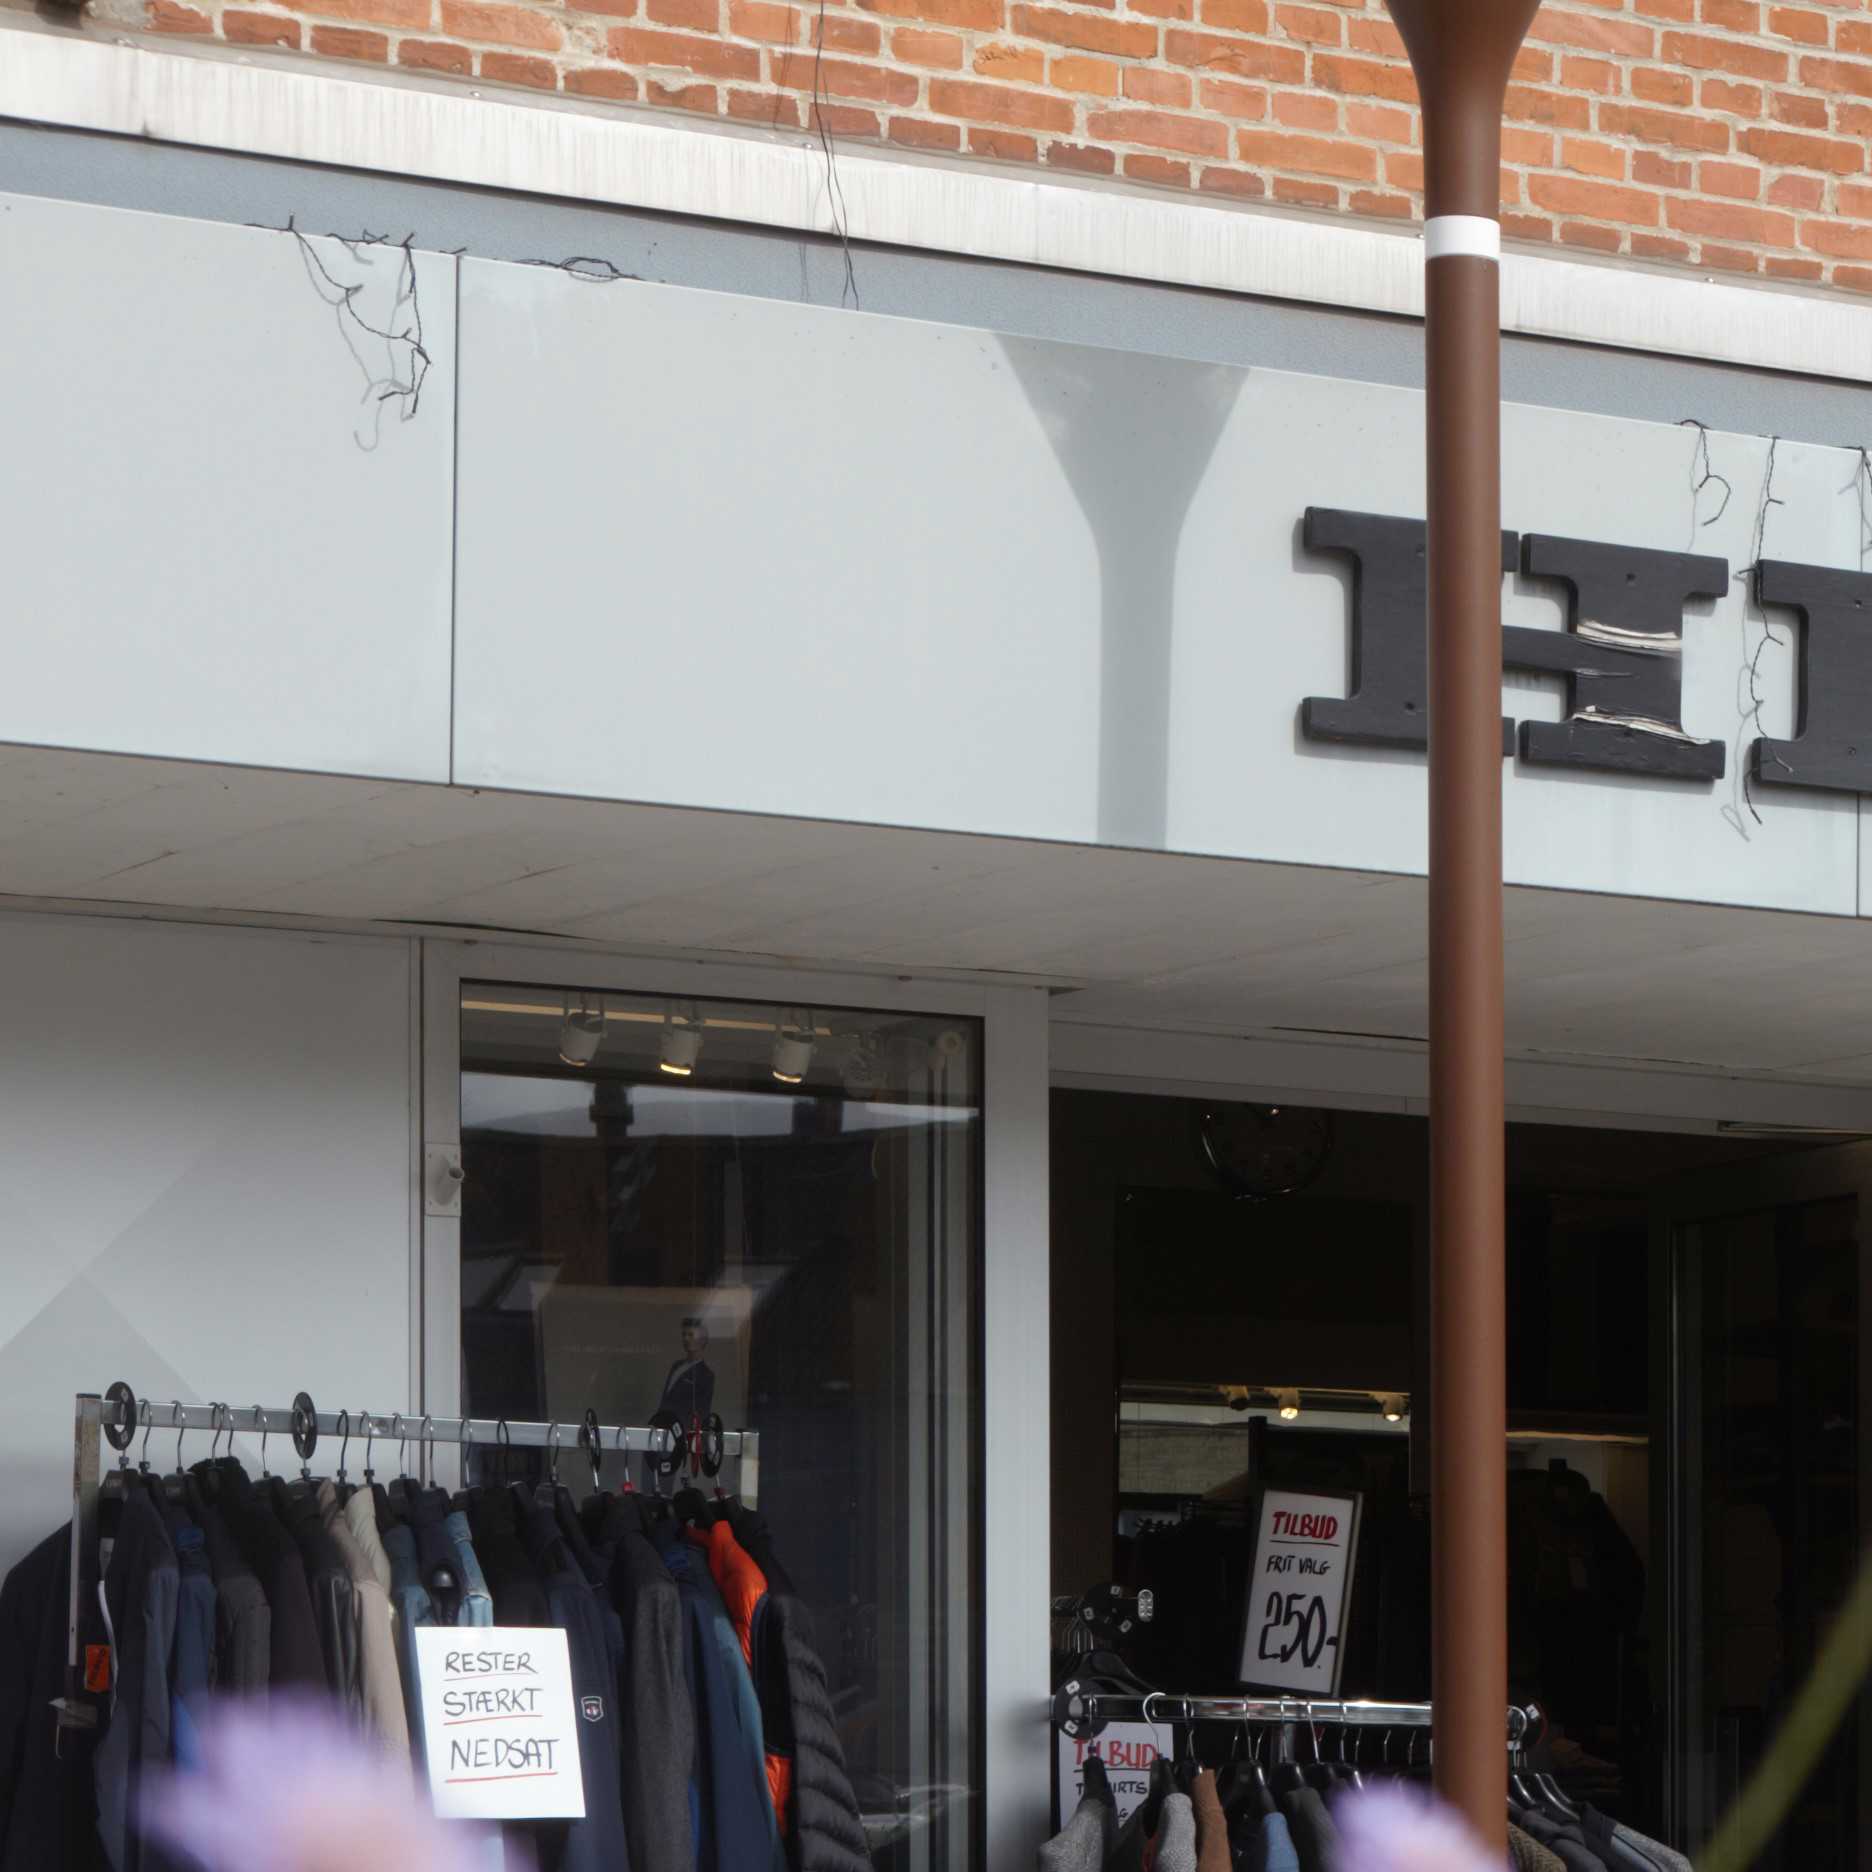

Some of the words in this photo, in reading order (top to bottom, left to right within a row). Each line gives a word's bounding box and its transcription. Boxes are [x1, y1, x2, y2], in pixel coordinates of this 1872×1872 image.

[1272, 1511, 1339, 1539] TILBUD
[1266, 1555, 1296, 1574] FRIT
[1299, 1557, 1331, 1575] VALG
[445, 1651, 538, 1673] RESTER
[443, 1687, 544, 1717] STÆRKT
[451, 1738, 560, 1770] NEDSAT
[1073, 1738, 1158, 1768] TLBUD
